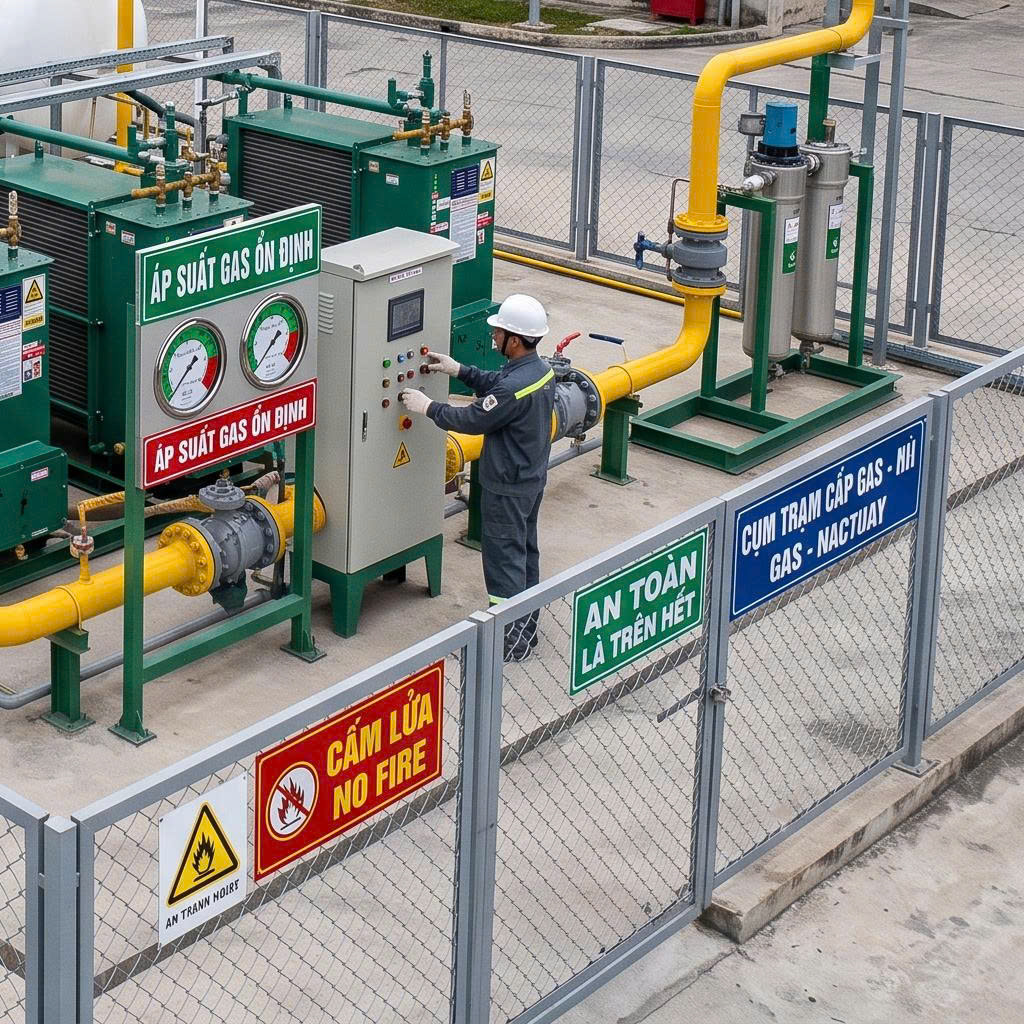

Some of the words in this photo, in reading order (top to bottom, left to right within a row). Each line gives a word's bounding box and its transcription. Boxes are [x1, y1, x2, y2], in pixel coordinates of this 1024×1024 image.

[150, 263, 172, 304] ÁP
[176, 246, 216, 298] SUẤT
[220, 247, 250, 285] GAS
[255, 229, 275, 275] ỔN
[279, 229, 313, 273] ĐỊNH
[154, 439, 174, 473] ÁP
[178, 424, 216, 464] SUẤT
[219, 419, 248, 449] GAS
[274, 397, 308, 431] ĐỊNH
[741, 513, 776, 557] CỤM
[780, 494, 822, 534] TRẠM
[825, 464, 853, 513] CẤP
[857, 457, 884, 492] GAS
[769, 546, 802, 583] GAS
[817, 496, 887, 558] NACTUAY
[581, 635, 605, 675] LÀ
[610, 611, 657, 659] TRÊN
[661, 587, 696, 628] HẾT
[584, 590, 622, 636] AN
[629, 550, 697, 612] TOÀN
[327, 717, 382, 777] CẤM
[389, 689, 433, 744] LỬA
[333, 772, 368, 821] NO
[376, 739, 427, 796] FIRE
[166, 914, 179, 930] AN
